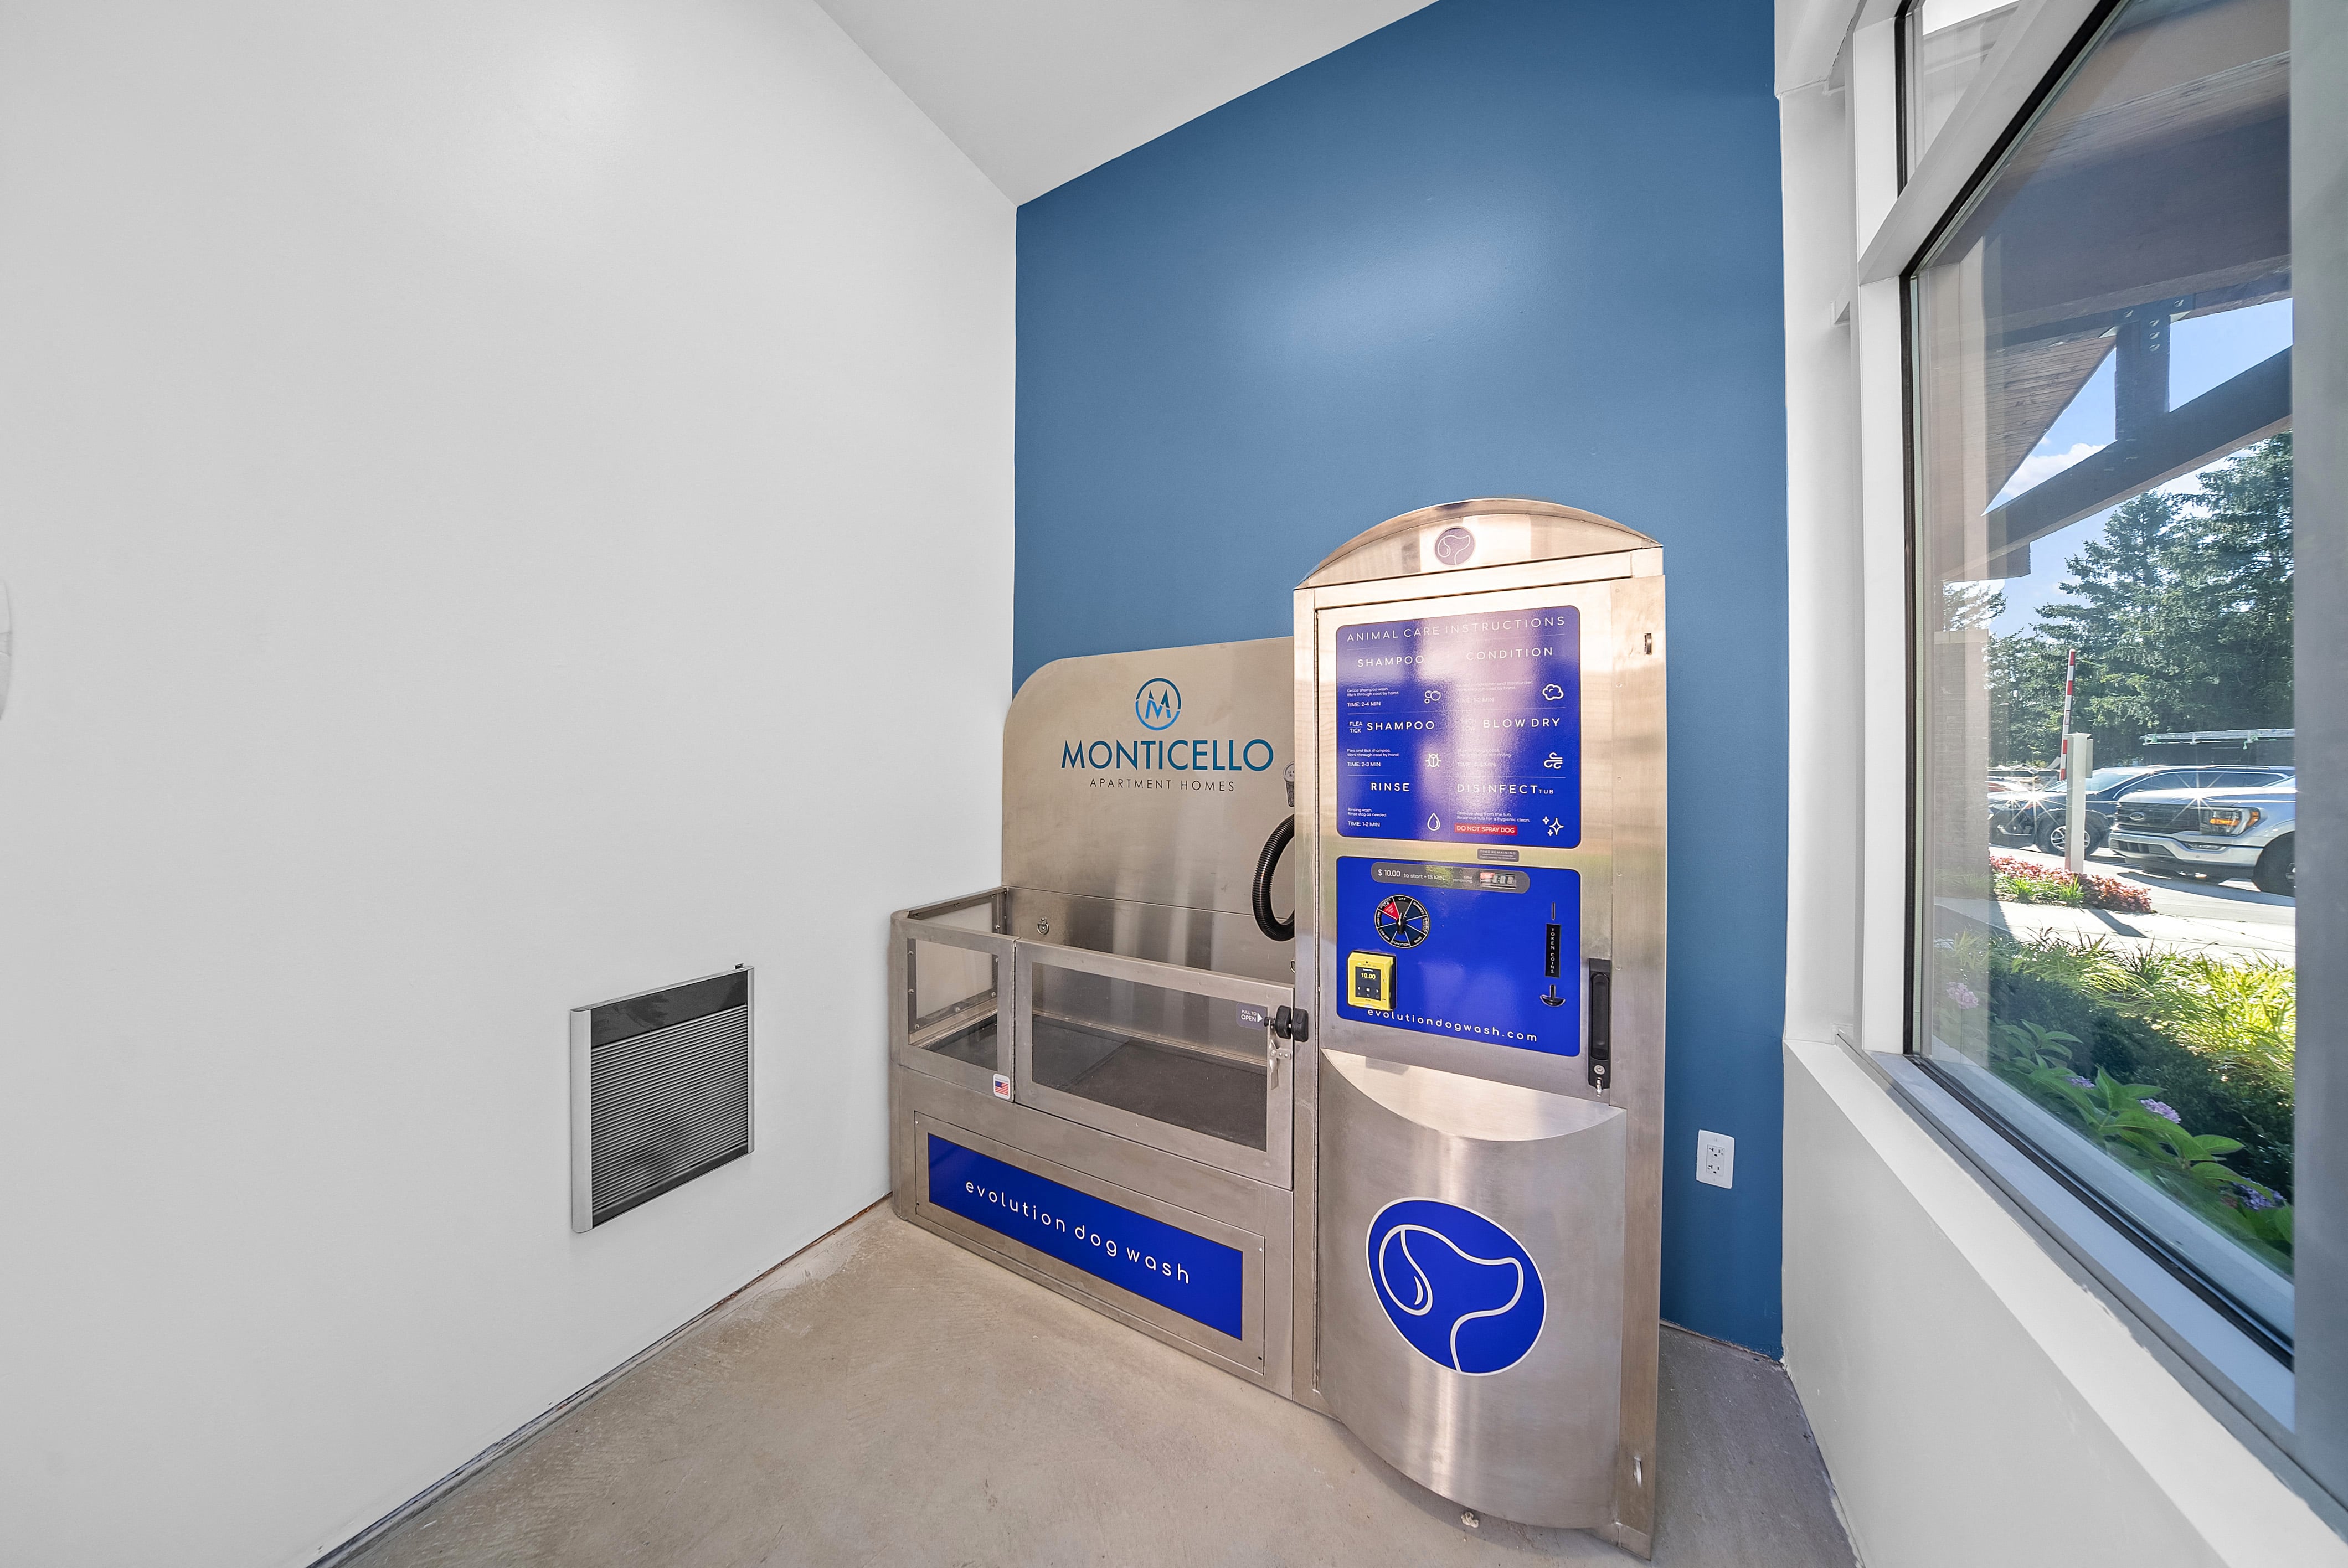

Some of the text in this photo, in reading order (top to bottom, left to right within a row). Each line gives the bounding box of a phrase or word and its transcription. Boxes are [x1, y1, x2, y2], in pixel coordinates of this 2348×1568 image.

[1347, 616, 1565, 642] ANIMAL CARE INSTRUCTIONS
[1466, 646, 1553, 661] CONDITION
[1357, 655, 1424, 668] SHAMPOO
[1367, 721, 1435, 731] SHAMPOO
[1484, 719, 1525, 728] BLOW
[1531, 718, 1560, 727] DRY
[1061, 739, 1274, 772] MONTICELLO
[1090, 778, 1235, 792] APARTMENT HOMES
[1371, 782, 1410, 791] RINSE
[1457, 784, 1538, 794] DISINFECT
[1378, 868, 1383, 876] $
[1367, 1009, 1537, 1042] evolutiondogwash.com
[965, 1180, 1189, 1284] evolution dog wash
